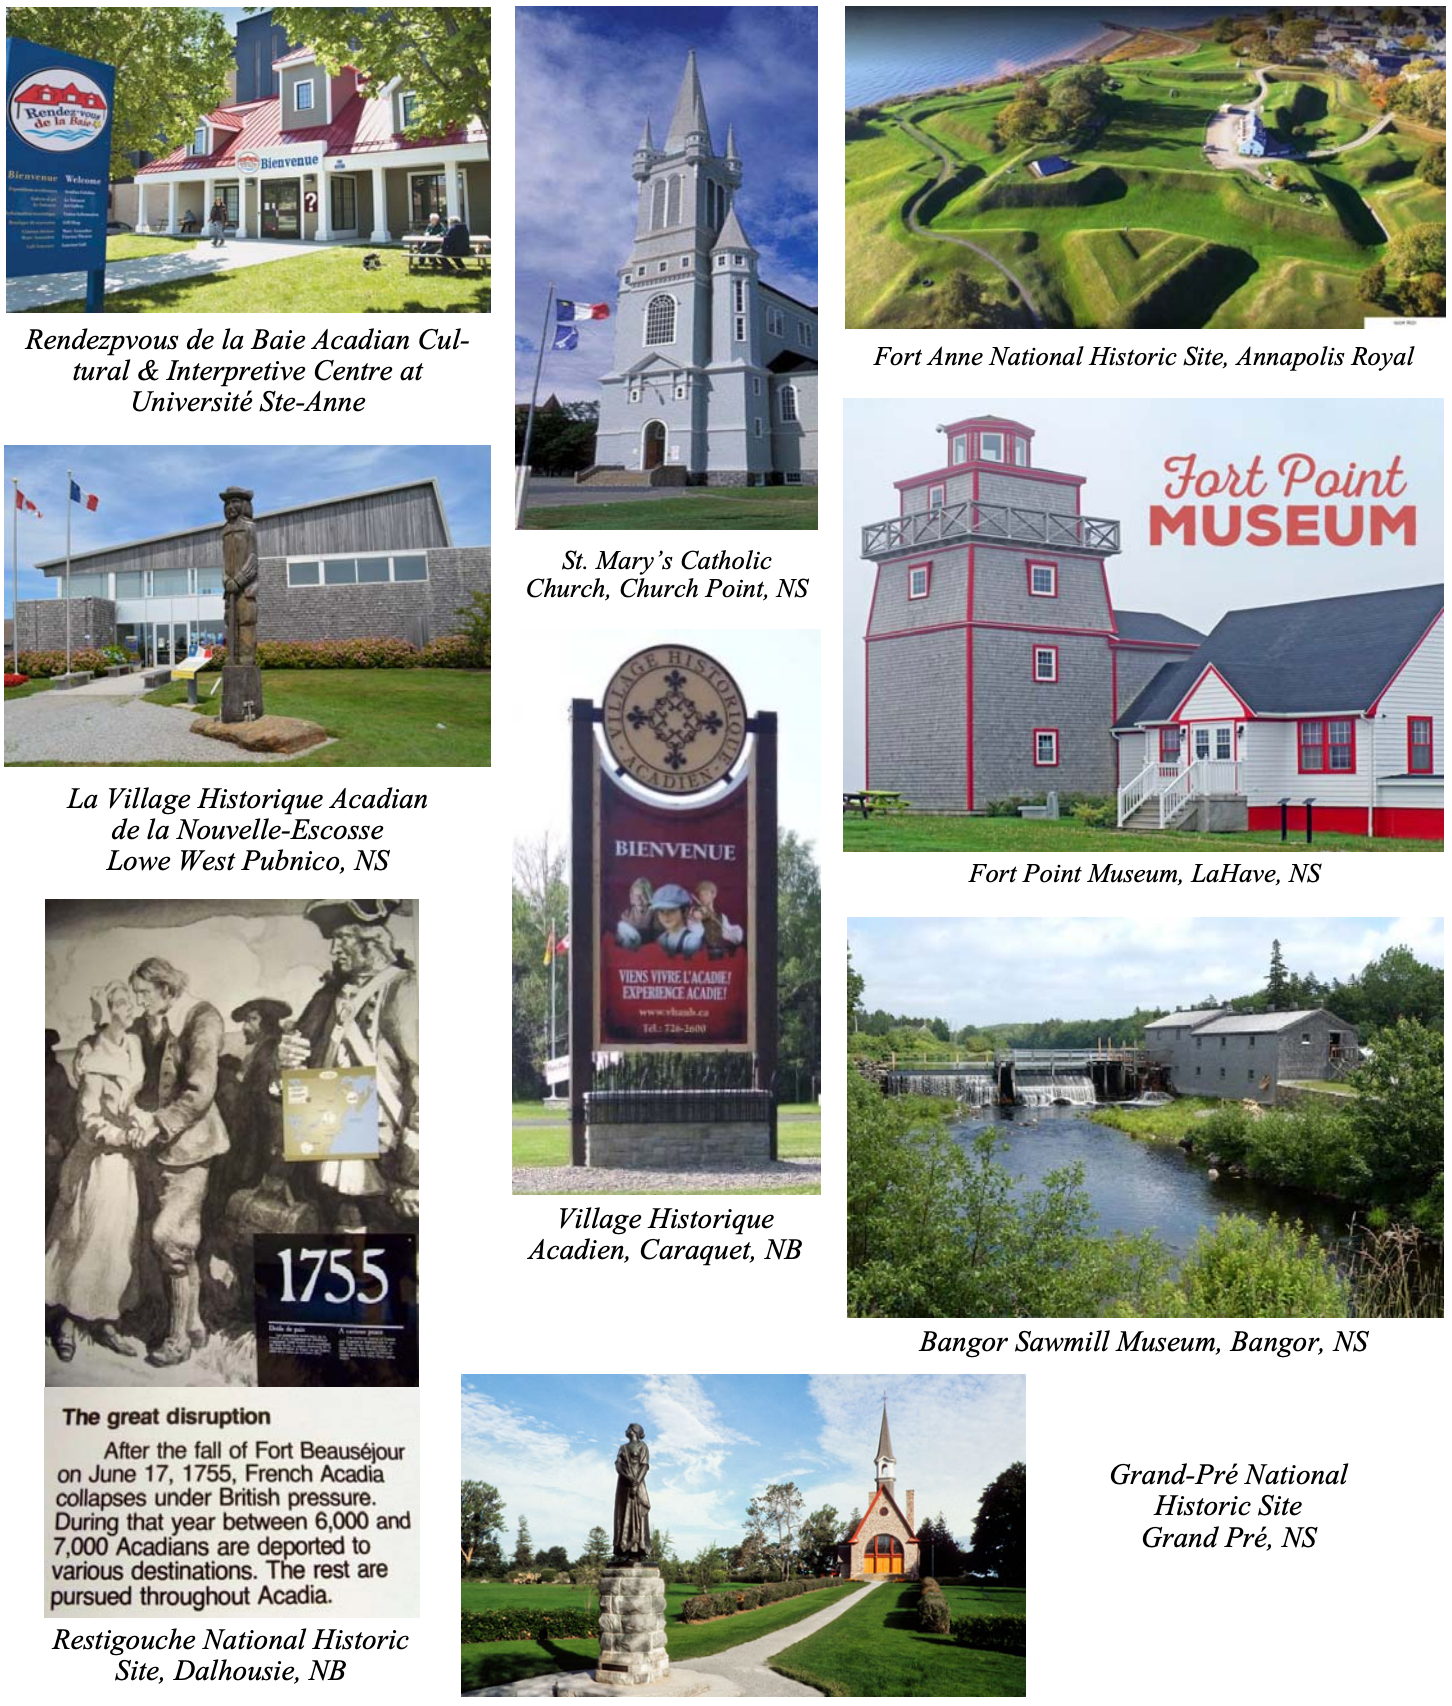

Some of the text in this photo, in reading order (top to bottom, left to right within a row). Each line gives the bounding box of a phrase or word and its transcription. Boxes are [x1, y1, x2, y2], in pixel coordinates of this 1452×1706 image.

[25, 106, 101, 120] Rendez-vous
[34, 116, 92, 129] de la Baie
[261, 155, 319, 170] Bienvenue
[7, 170, 58, 182] Bienvenue
[65, 174, 101, 185] Welcome
[608, 651, 742, 768] VILLAGE HISTORIQUE
[621, 754, 716, 790] ACADIEN
[615, 840, 736, 861] BIENVENUE
[619, 969, 732, 985] VIENS VIVRE L'ACADIE!
[622, 986, 727, 1001] EXPERIENCE ACADIE!
[277, 1248, 389, 1304] 1755
[62, 1407, 270, 1429] The great disruption
[104, 1441, 405, 1465] After the fall of Fort Beauséjour
[58, 1464, 384, 1485] on June 17, 1755, French Acadia
[56, 1487, 375, 1511] collapses under British pressure.
[55, 1511, 410, 1536] During that year between 6,000 and
[54, 1536, 370, 1560] 7,000 Acadians are deported to
[52, 1560, 388, 1580] various destinations. The rest are
[51, 1585, 332, 1611] pursued throughout Acadia.
